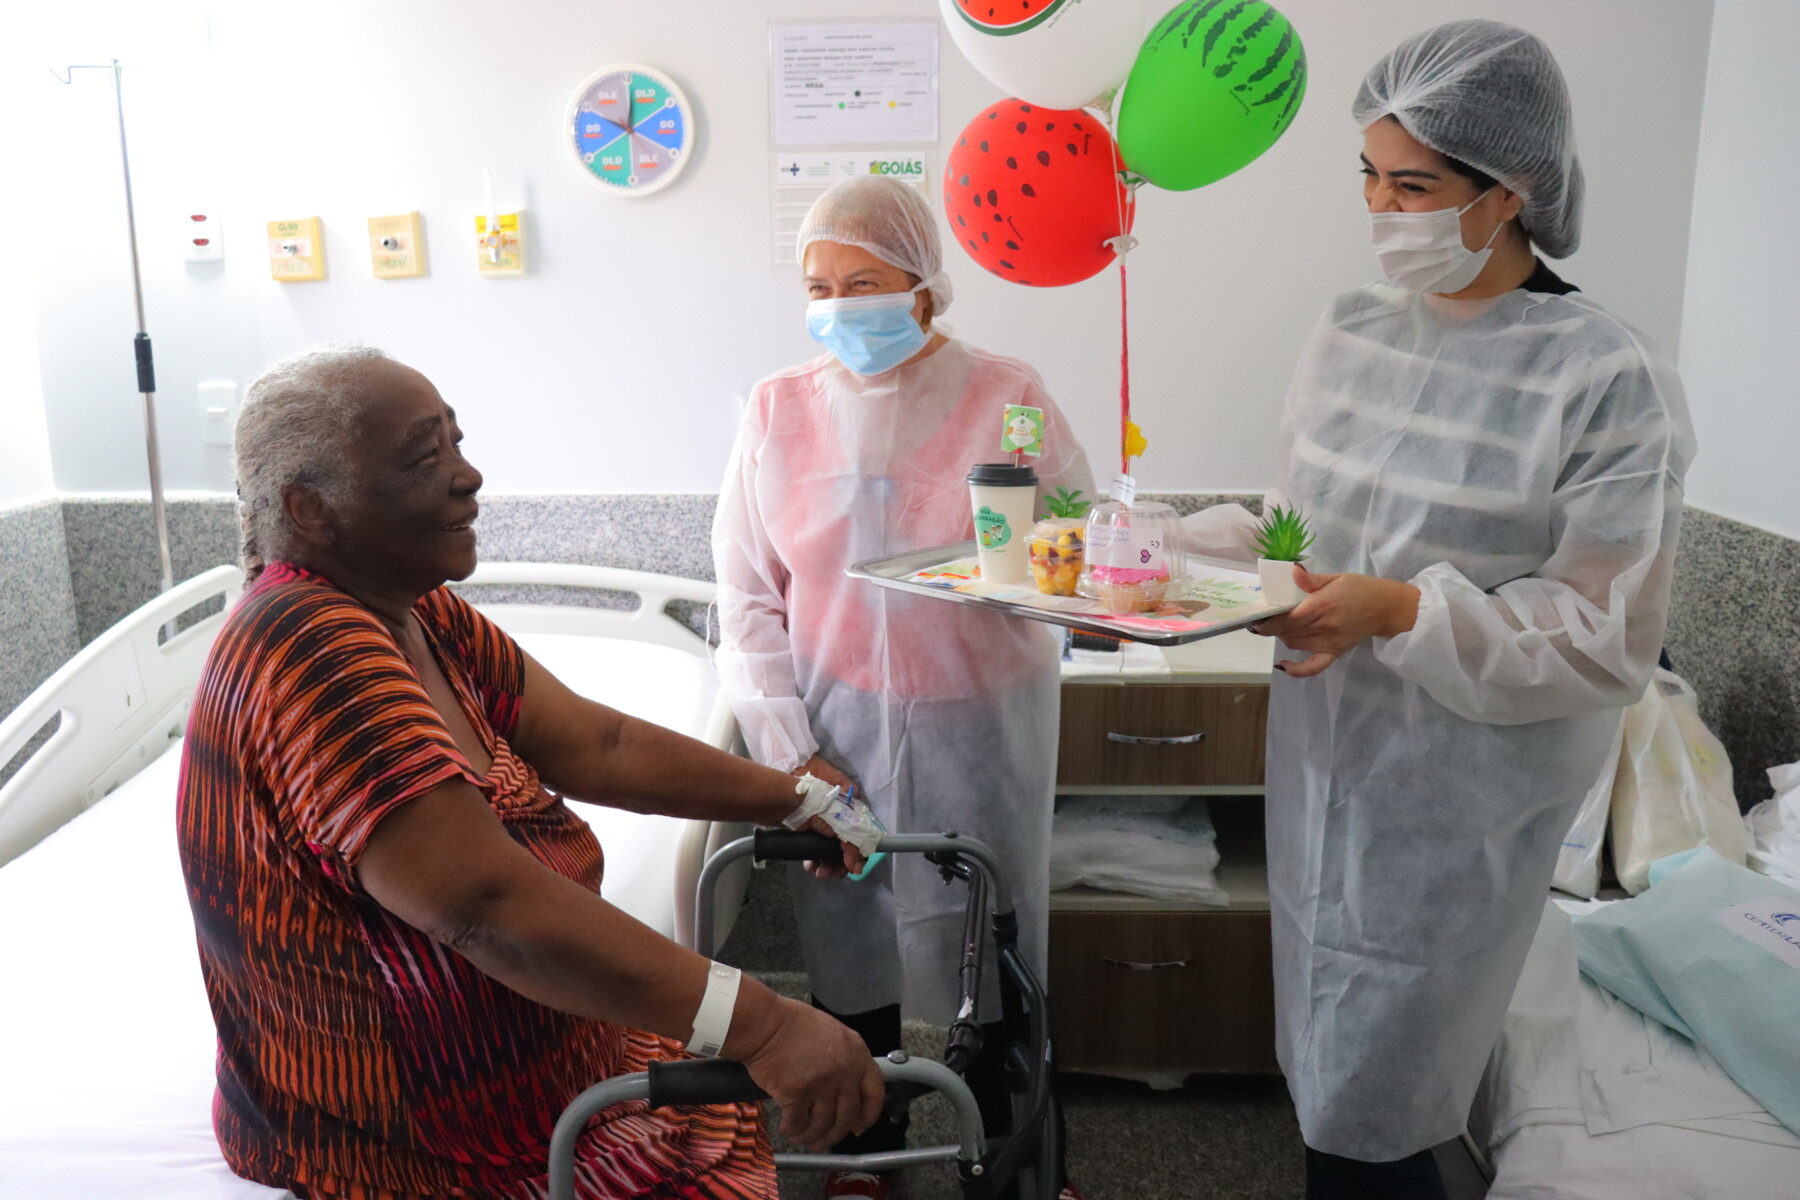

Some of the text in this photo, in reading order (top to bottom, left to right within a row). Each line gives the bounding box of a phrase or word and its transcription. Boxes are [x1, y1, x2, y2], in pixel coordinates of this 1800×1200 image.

[598, 91, 618, 99] DLE
[635, 88, 656, 98] DLD
[586, 124, 601, 132] DD
[660, 120, 675, 129] DD
[602, 156, 623, 165] DLD
[879, 158, 923, 175] GOIÁS
